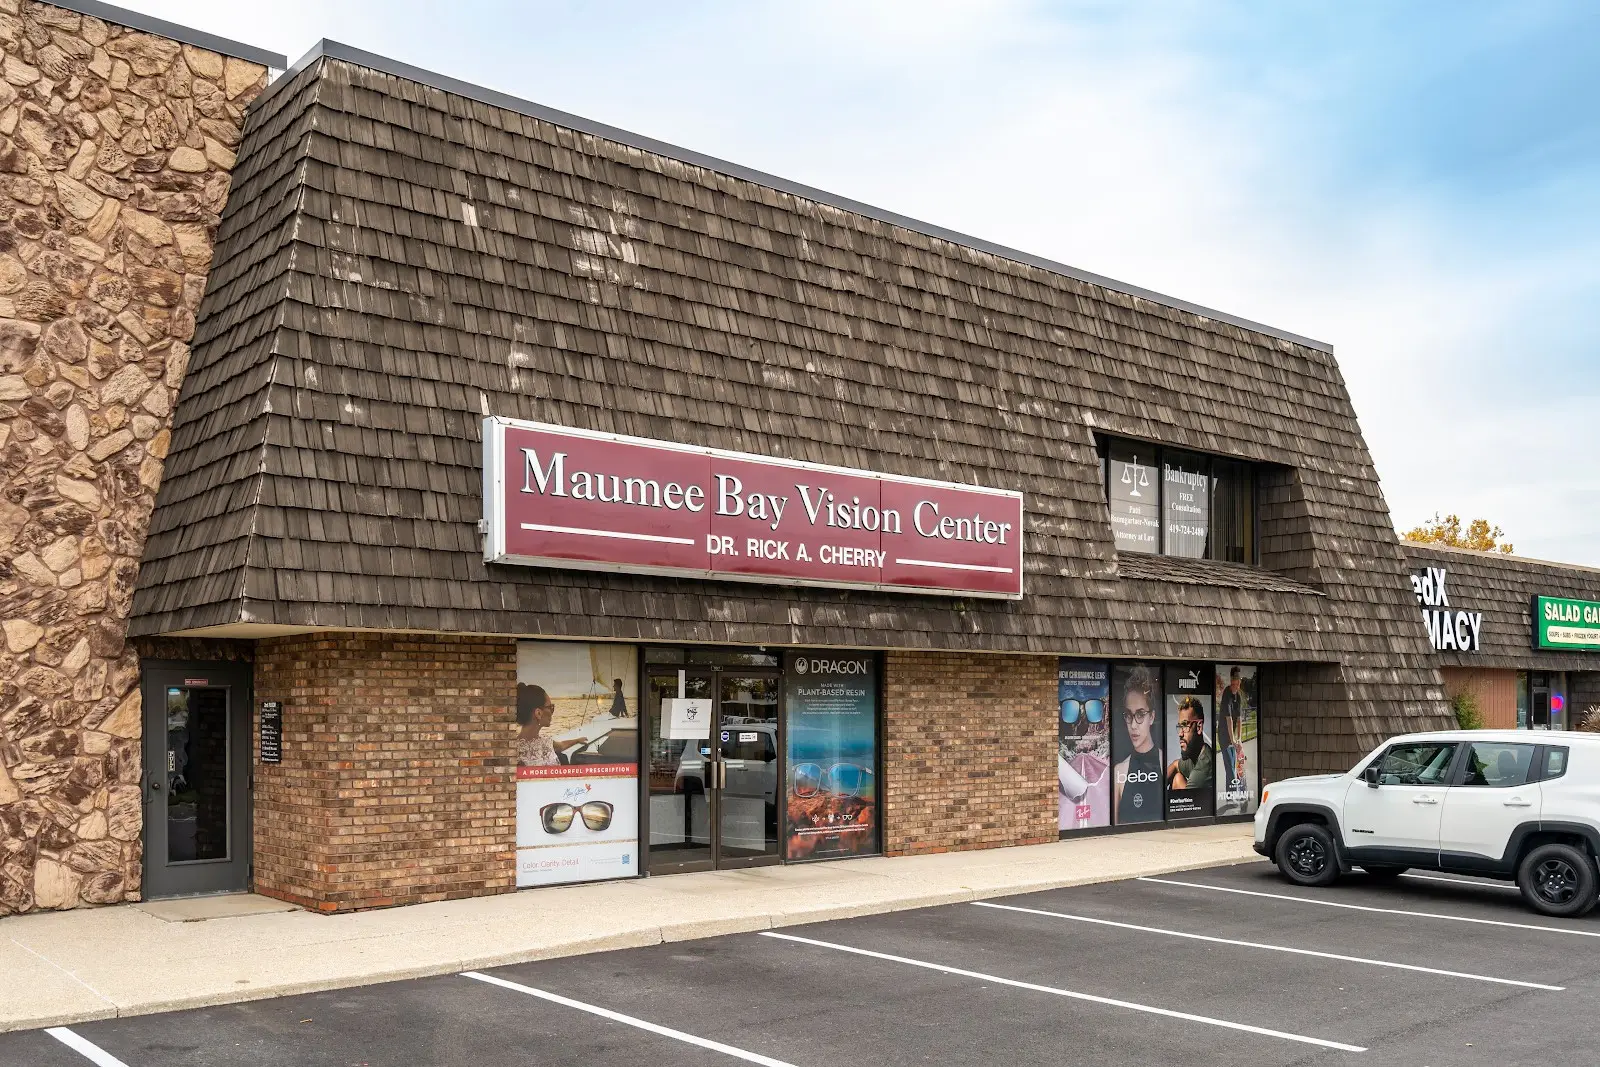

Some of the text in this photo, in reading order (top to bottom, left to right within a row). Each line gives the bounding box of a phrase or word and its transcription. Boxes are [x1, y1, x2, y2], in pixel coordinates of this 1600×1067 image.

[1165, 463, 1206, 492] Bankruptcy
[520, 447, 1011, 545] Maumee Bay Vision Center
[1179, 492, 1193, 502] FREE
[706, 534, 887, 568] DR. RICK A. CHERRY
[1544, 602, 1600, 624] SALAD GA
[811, 659, 867, 675] DRAGON
[797, 688, 845, 696] PLANT-BASED
[550, 767, 583, 775] COLORFUL
[585, 766, 630, 774] PRESCRIPTION
[1116, 769, 1158, 784] bebe
